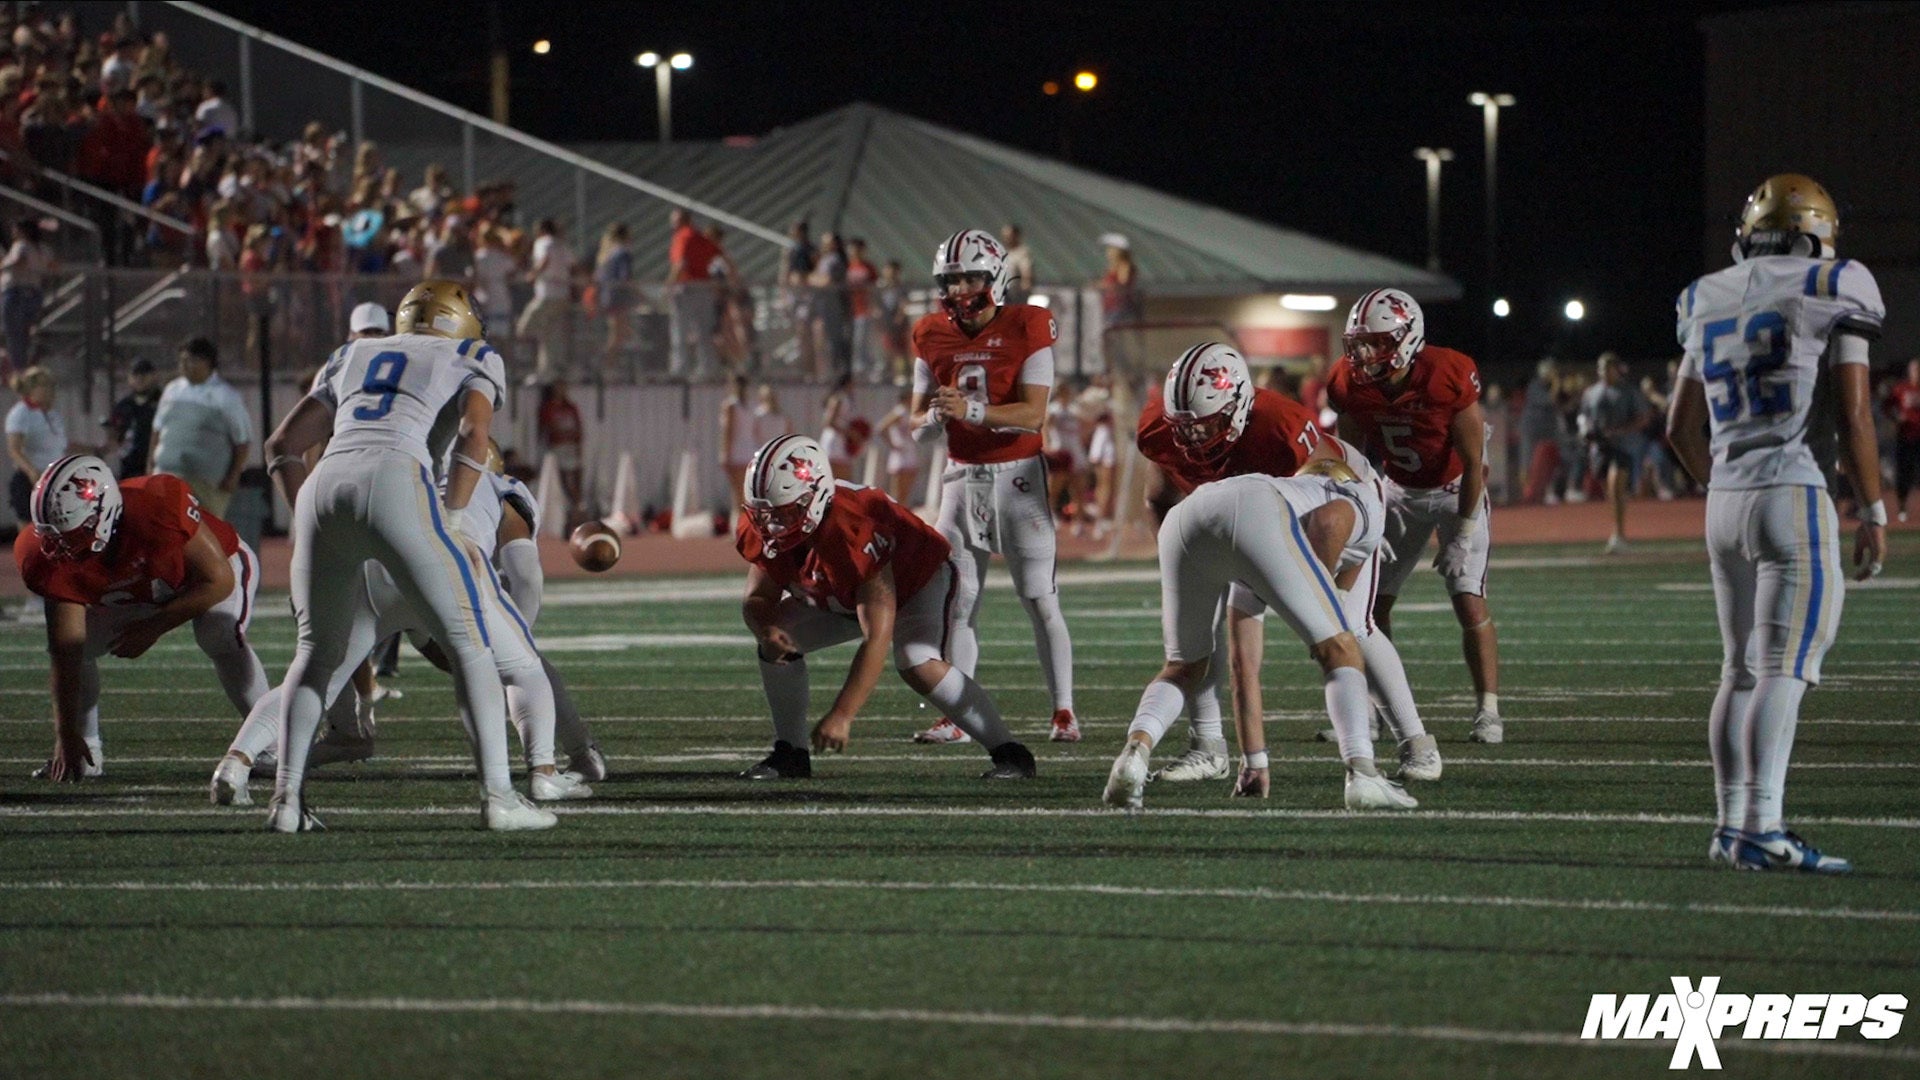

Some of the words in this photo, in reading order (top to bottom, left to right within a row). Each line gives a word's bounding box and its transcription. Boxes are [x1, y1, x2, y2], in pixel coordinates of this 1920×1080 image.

[1048, 319, 1057, 340] 8
[1470, 372, 1481, 392] 5
[1703, 311, 1792, 422] 52
[353, 351, 408, 420] 9
[1297, 420, 1320, 456] 77
[1381, 425, 1422, 473] 5
[863, 531, 888, 564] 74
